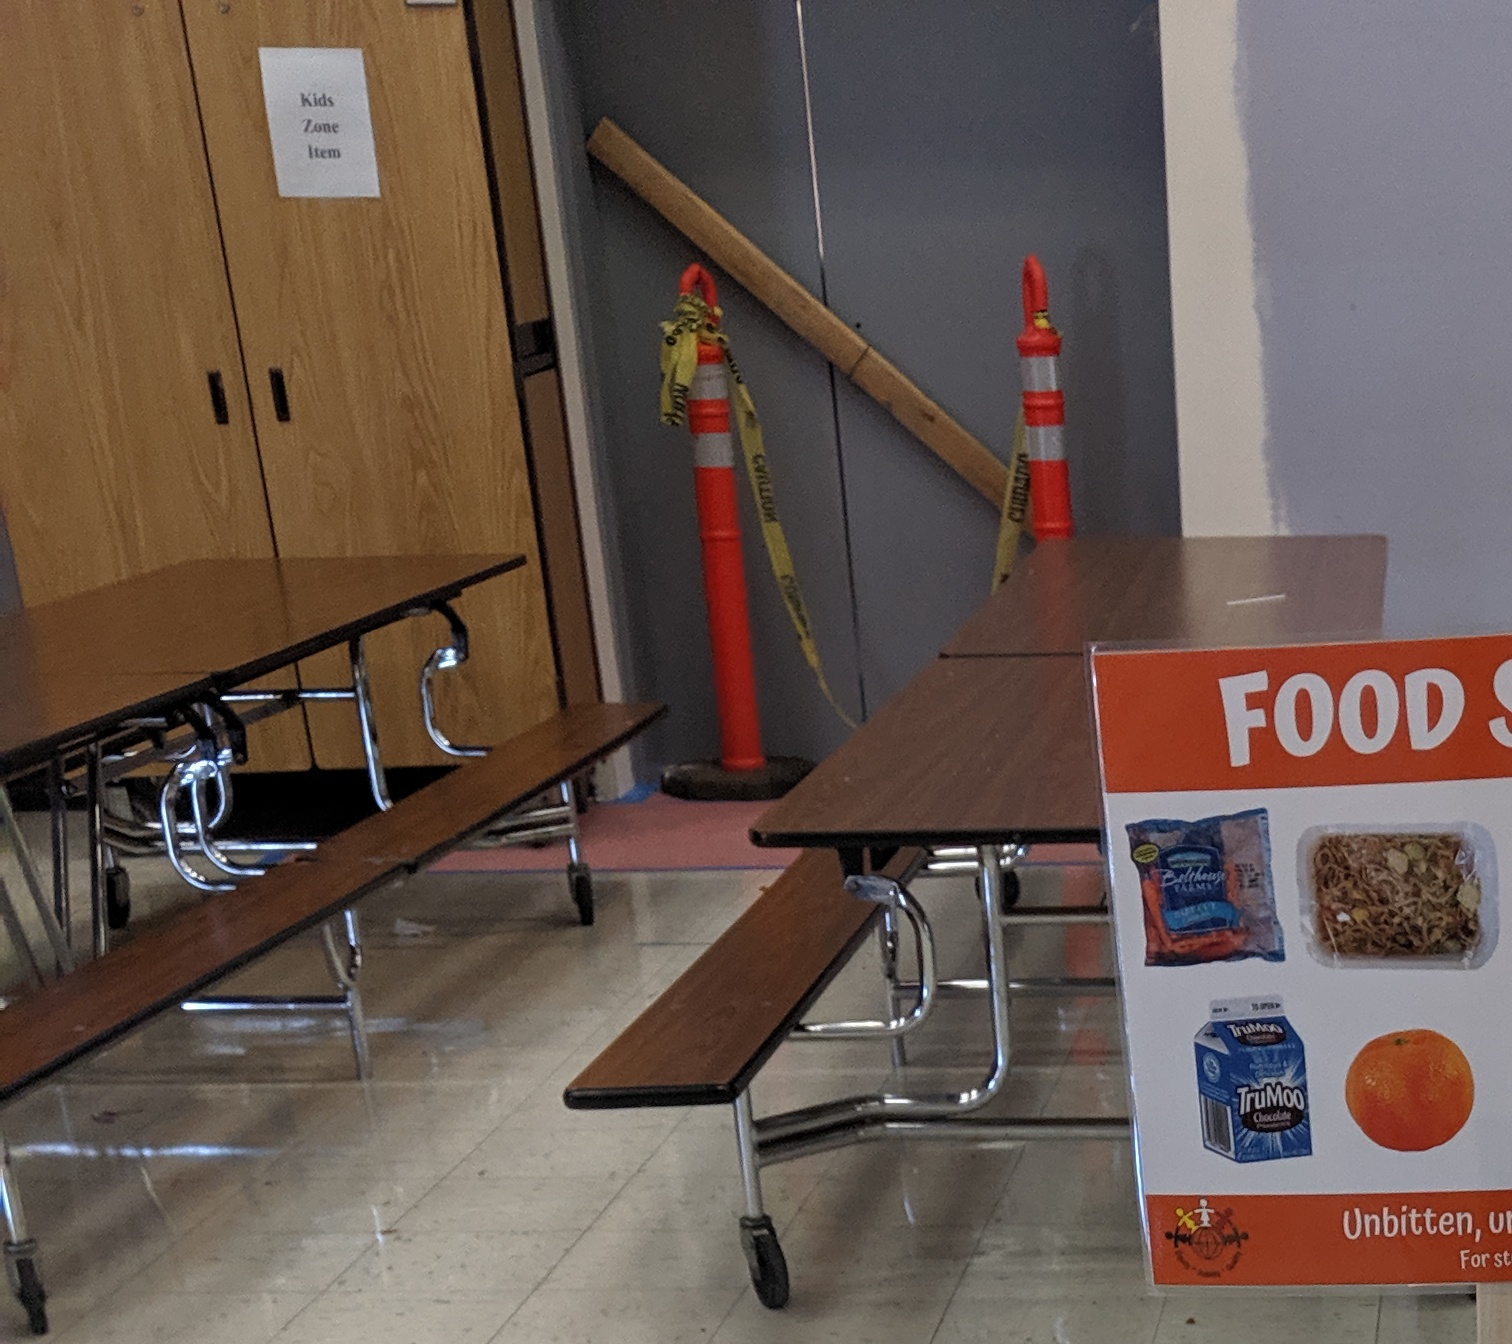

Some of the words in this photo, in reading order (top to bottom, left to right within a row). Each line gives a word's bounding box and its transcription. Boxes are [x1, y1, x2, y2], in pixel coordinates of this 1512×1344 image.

[300, 92, 335, 107] Kids
[302, 119, 340, 134] Zone
[307, 144, 342, 159] Item
[1219, 667, 1466, 768] FOOD
[1227, 1022, 1284, 1038] TruMoo
[1236, 1083, 1306, 1117] TruMoo
[1342, 1204, 1484, 1243] Unbitten,
[1459, 1247, 1491, 1270] For
